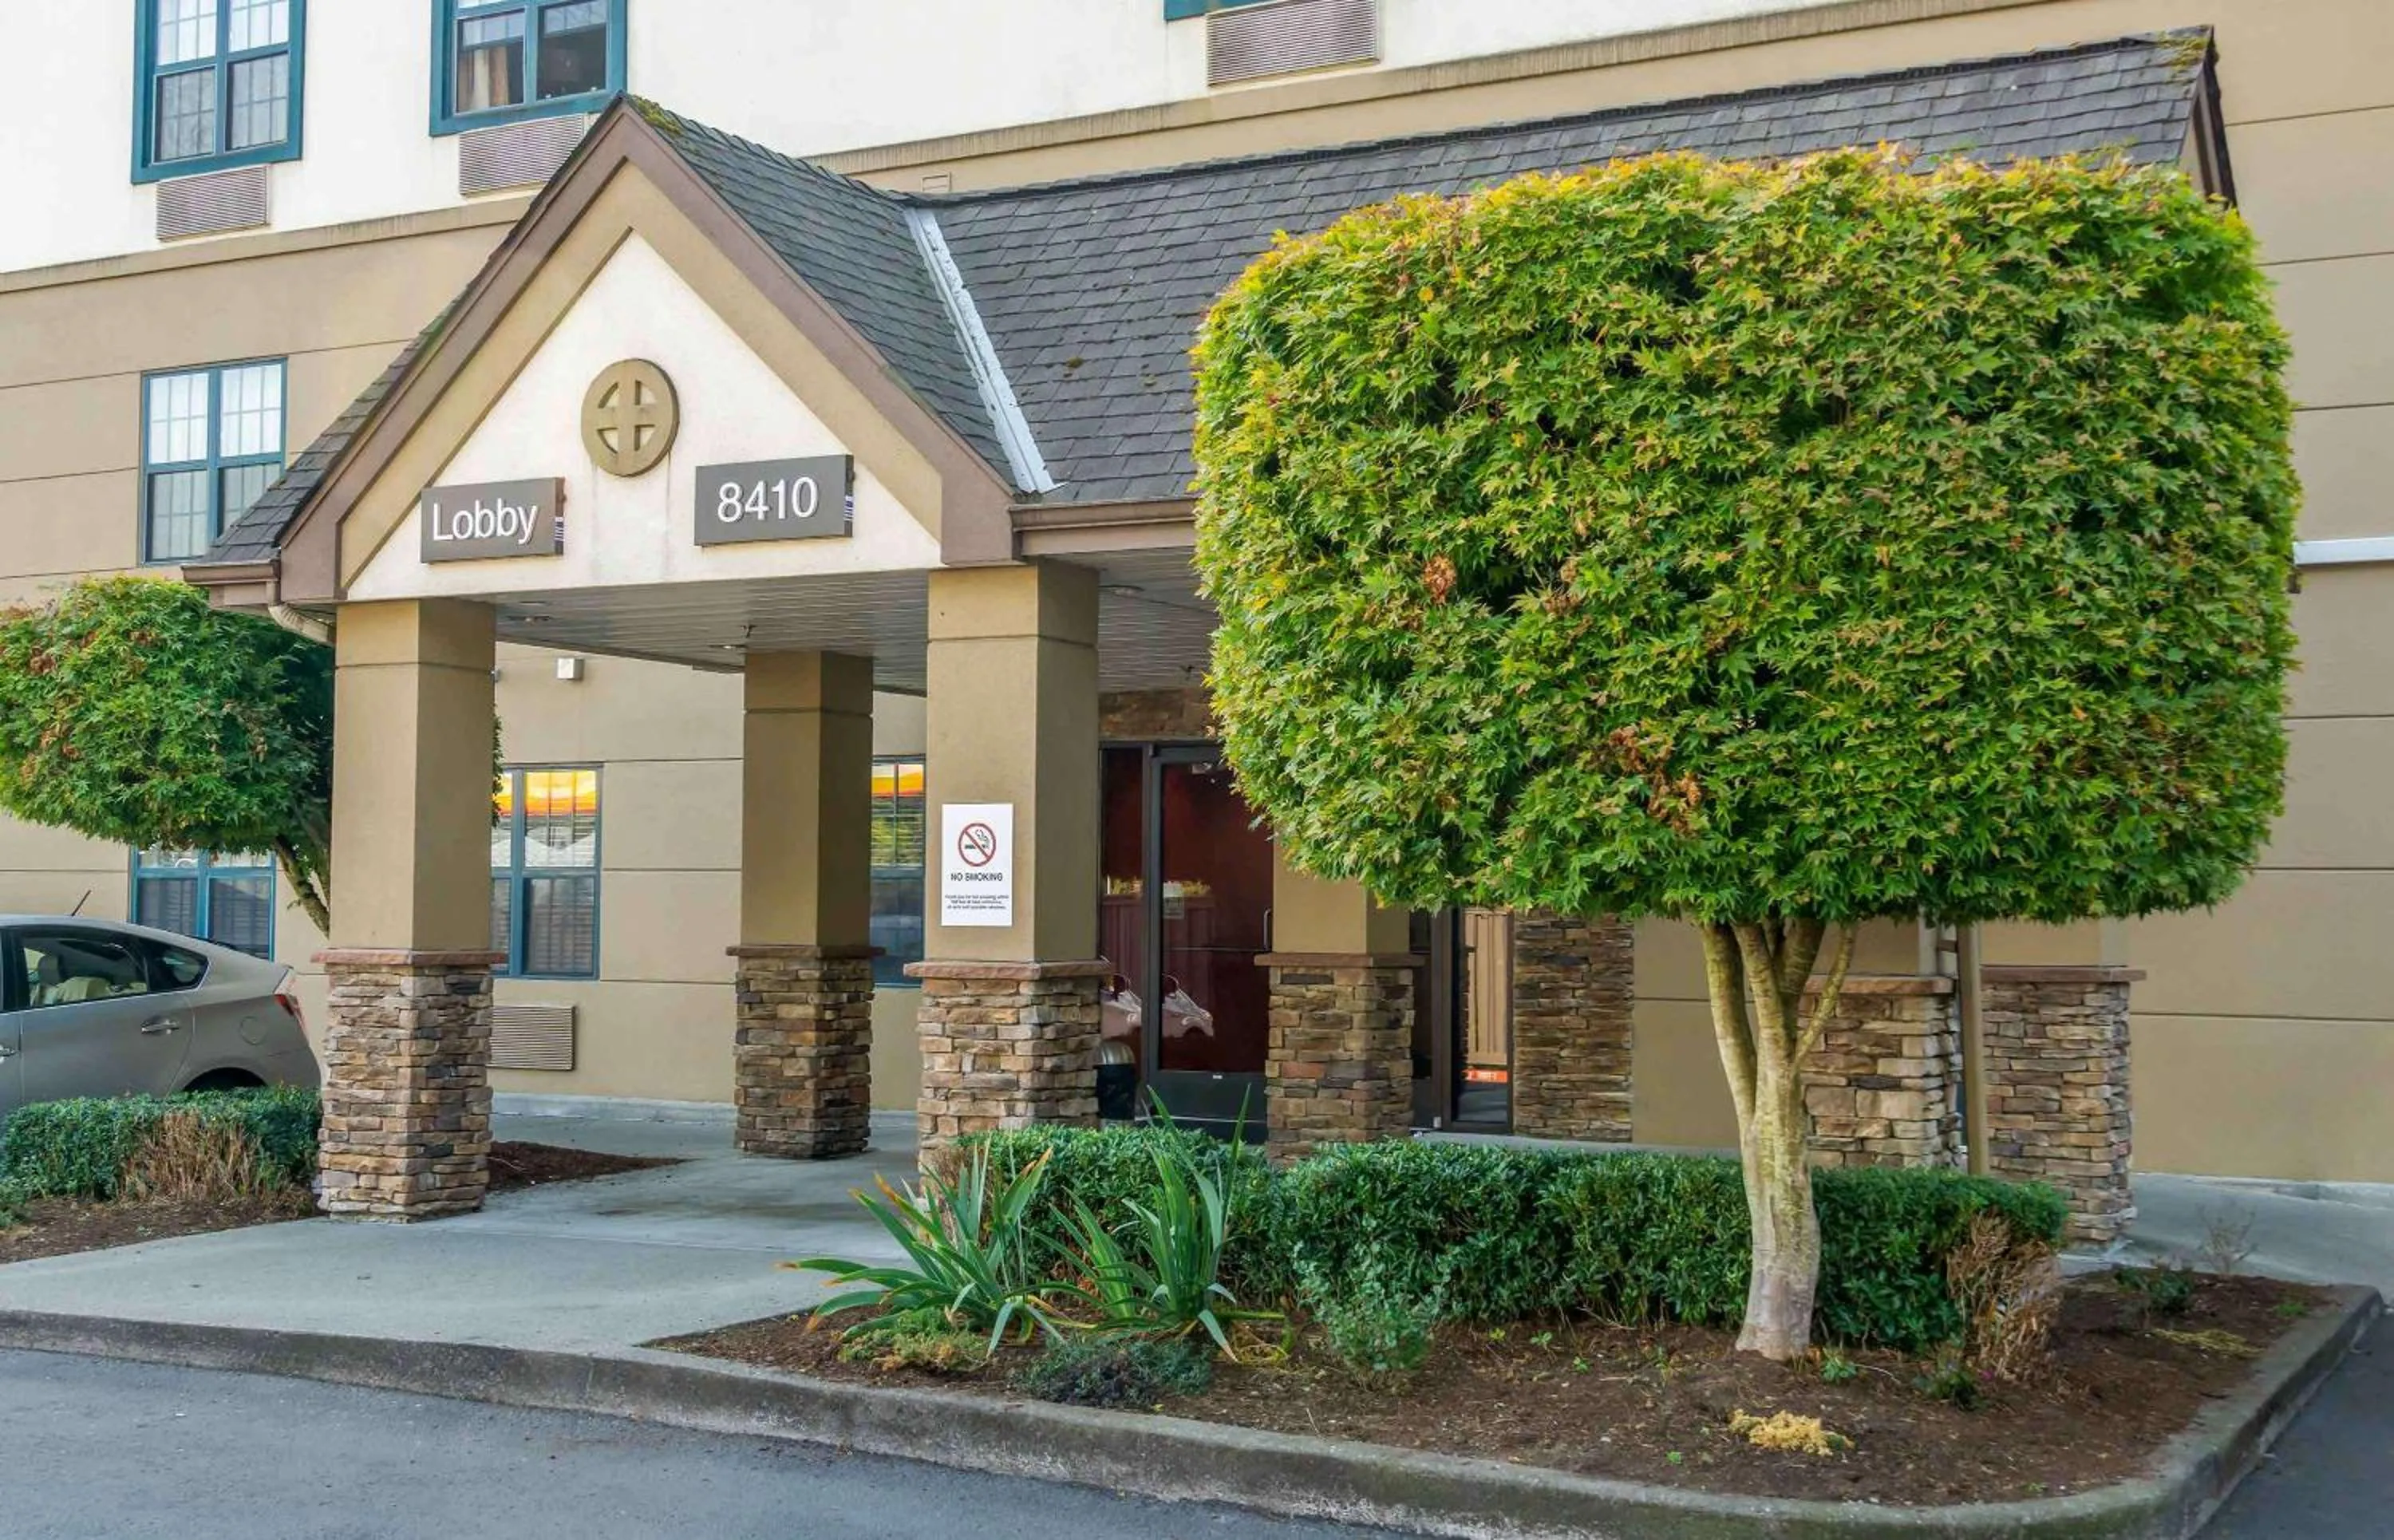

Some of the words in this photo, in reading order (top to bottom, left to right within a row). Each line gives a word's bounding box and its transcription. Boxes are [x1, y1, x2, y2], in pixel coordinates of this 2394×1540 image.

[433, 498, 538, 544] Lobby
[718, 476, 818, 522] 8410
[950, 872, 963, 882] NO
[965, 872, 1003, 882] SMOKING
